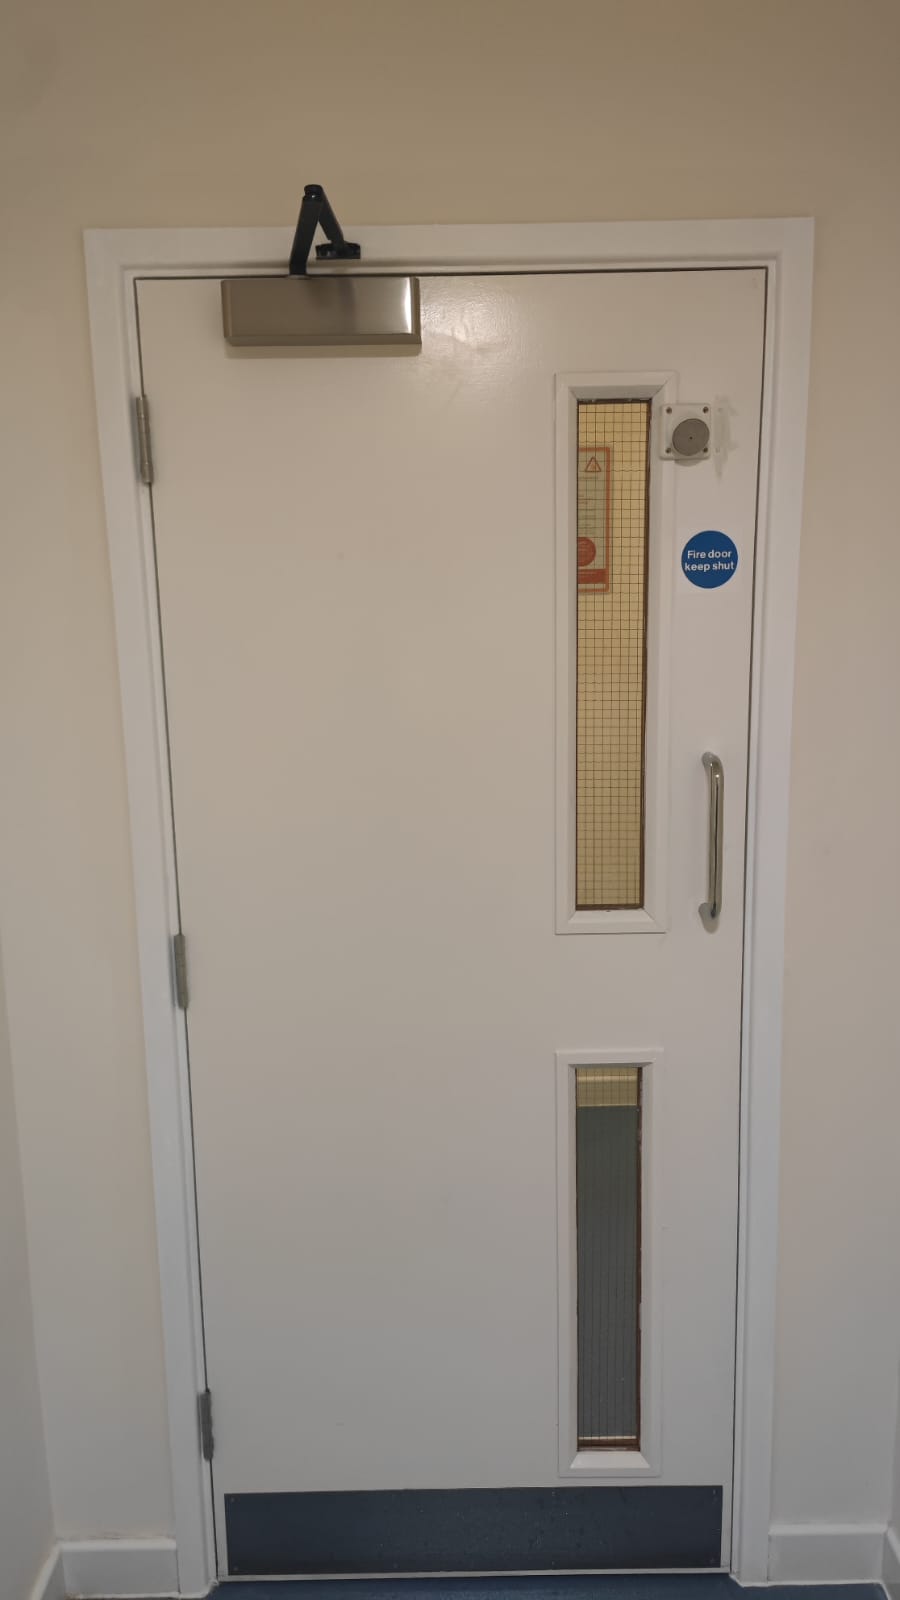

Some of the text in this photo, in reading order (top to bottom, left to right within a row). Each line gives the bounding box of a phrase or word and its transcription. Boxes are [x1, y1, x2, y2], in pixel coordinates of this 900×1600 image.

[687, 549, 732, 559] Fire door
[684, 561, 734, 572] keep shut
